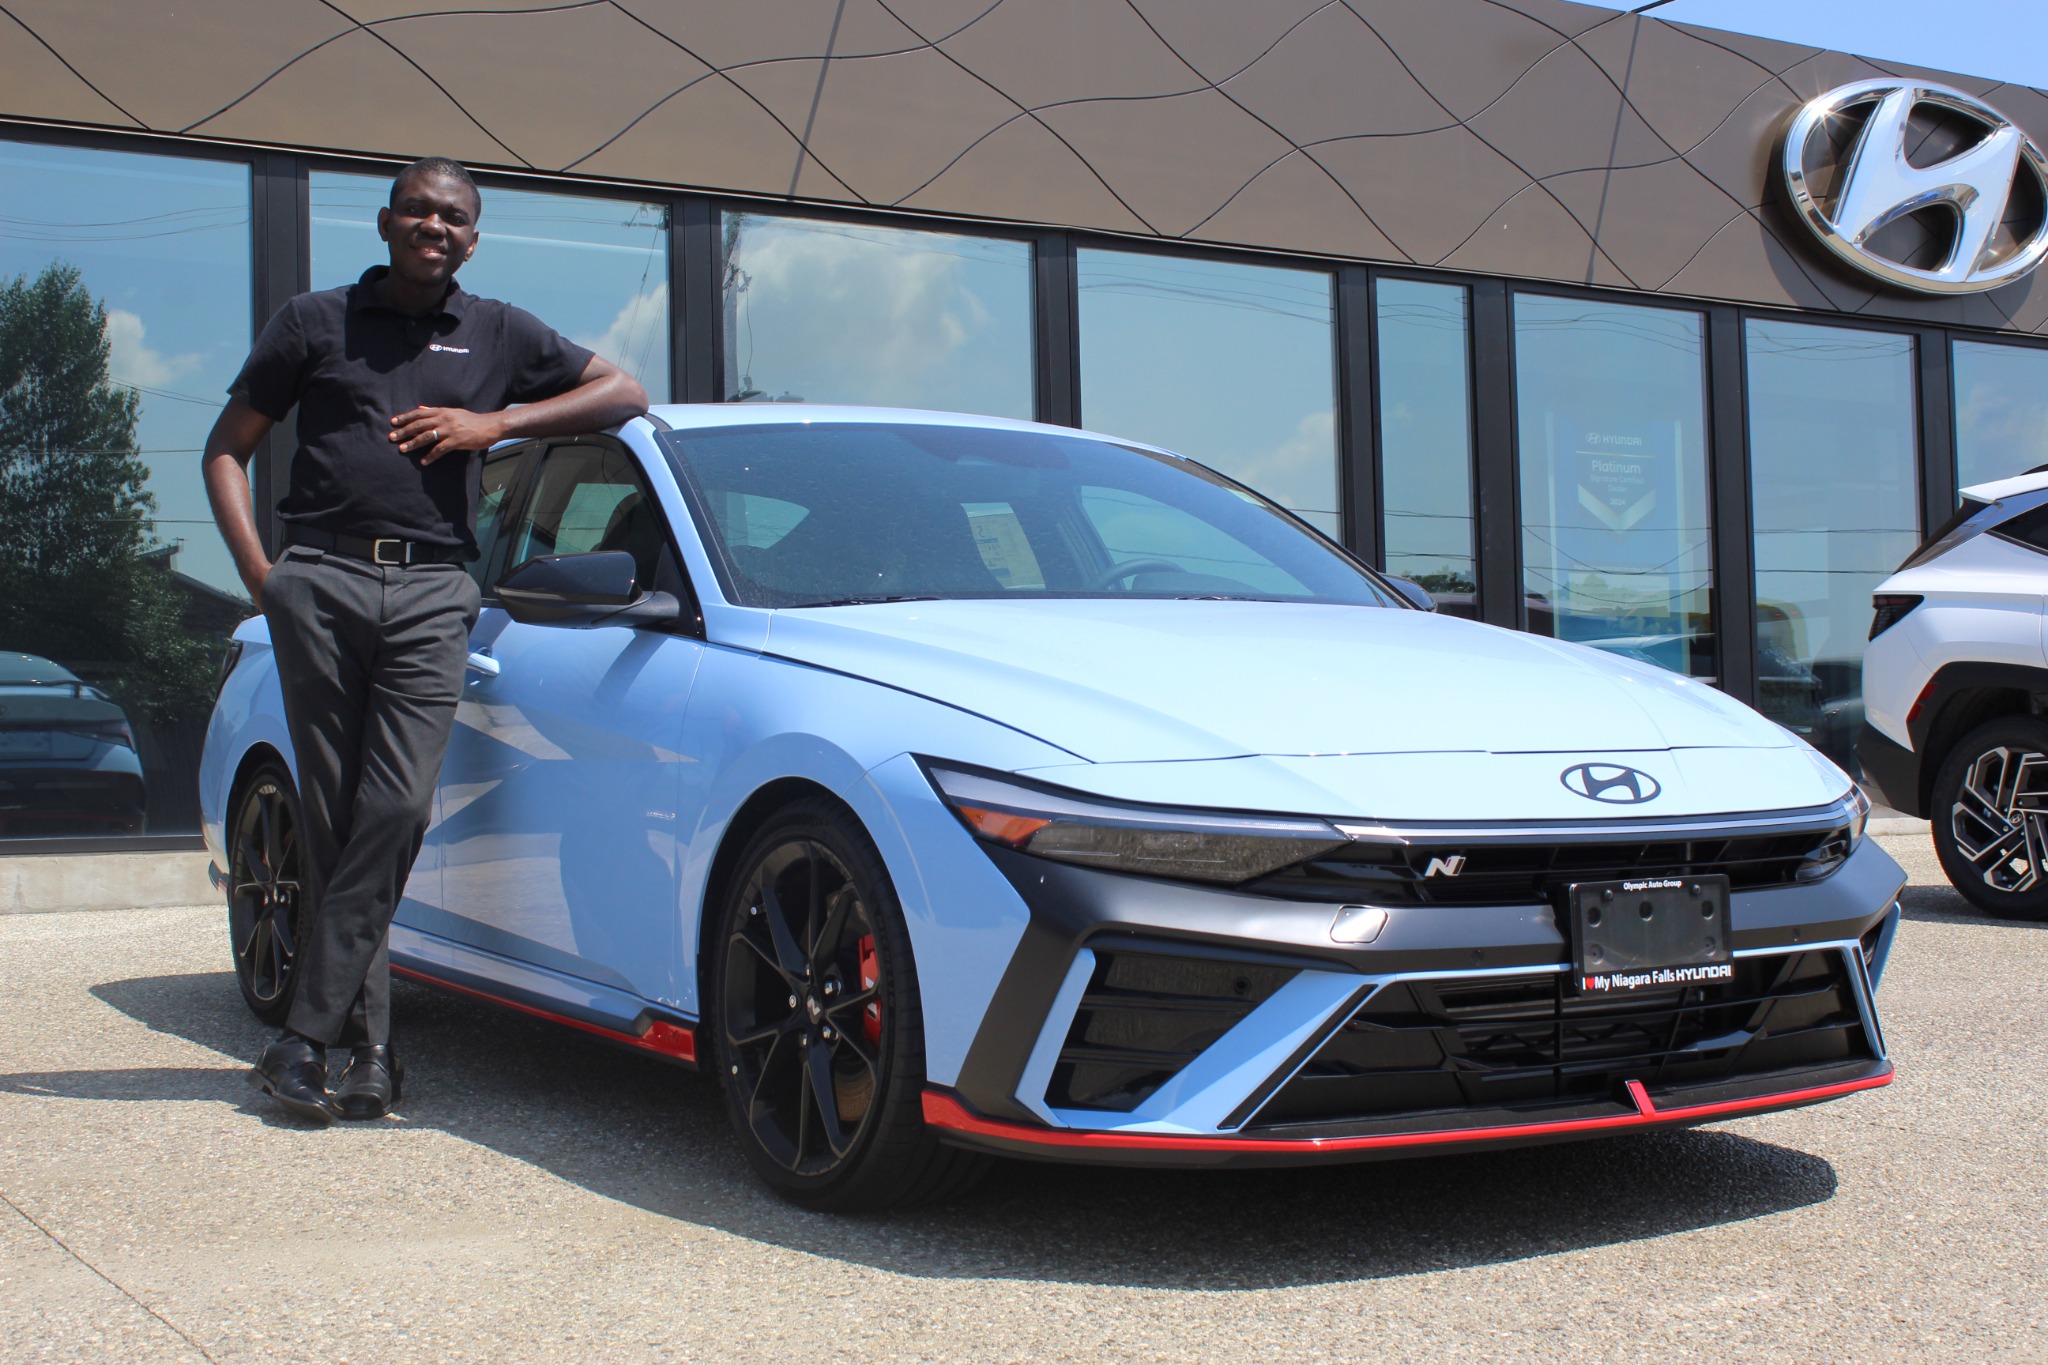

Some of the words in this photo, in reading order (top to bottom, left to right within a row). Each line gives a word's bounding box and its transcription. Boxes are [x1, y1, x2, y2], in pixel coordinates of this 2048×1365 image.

[1602, 435, 1642, 445] HYUNDAI
[1591, 459, 1641, 474] Platinum
[1623, 881, 1648, 891] Olympic
[1648, 880, 1663, 888] Auto
[1663, 880, 1681, 888] Group
[1594, 976, 1611, 991] My
[1612, 974, 1651, 989] Niagara
[1652, 969, 1675, 984] Falls
[1676, 964, 1732, 981] HYUNDAI
